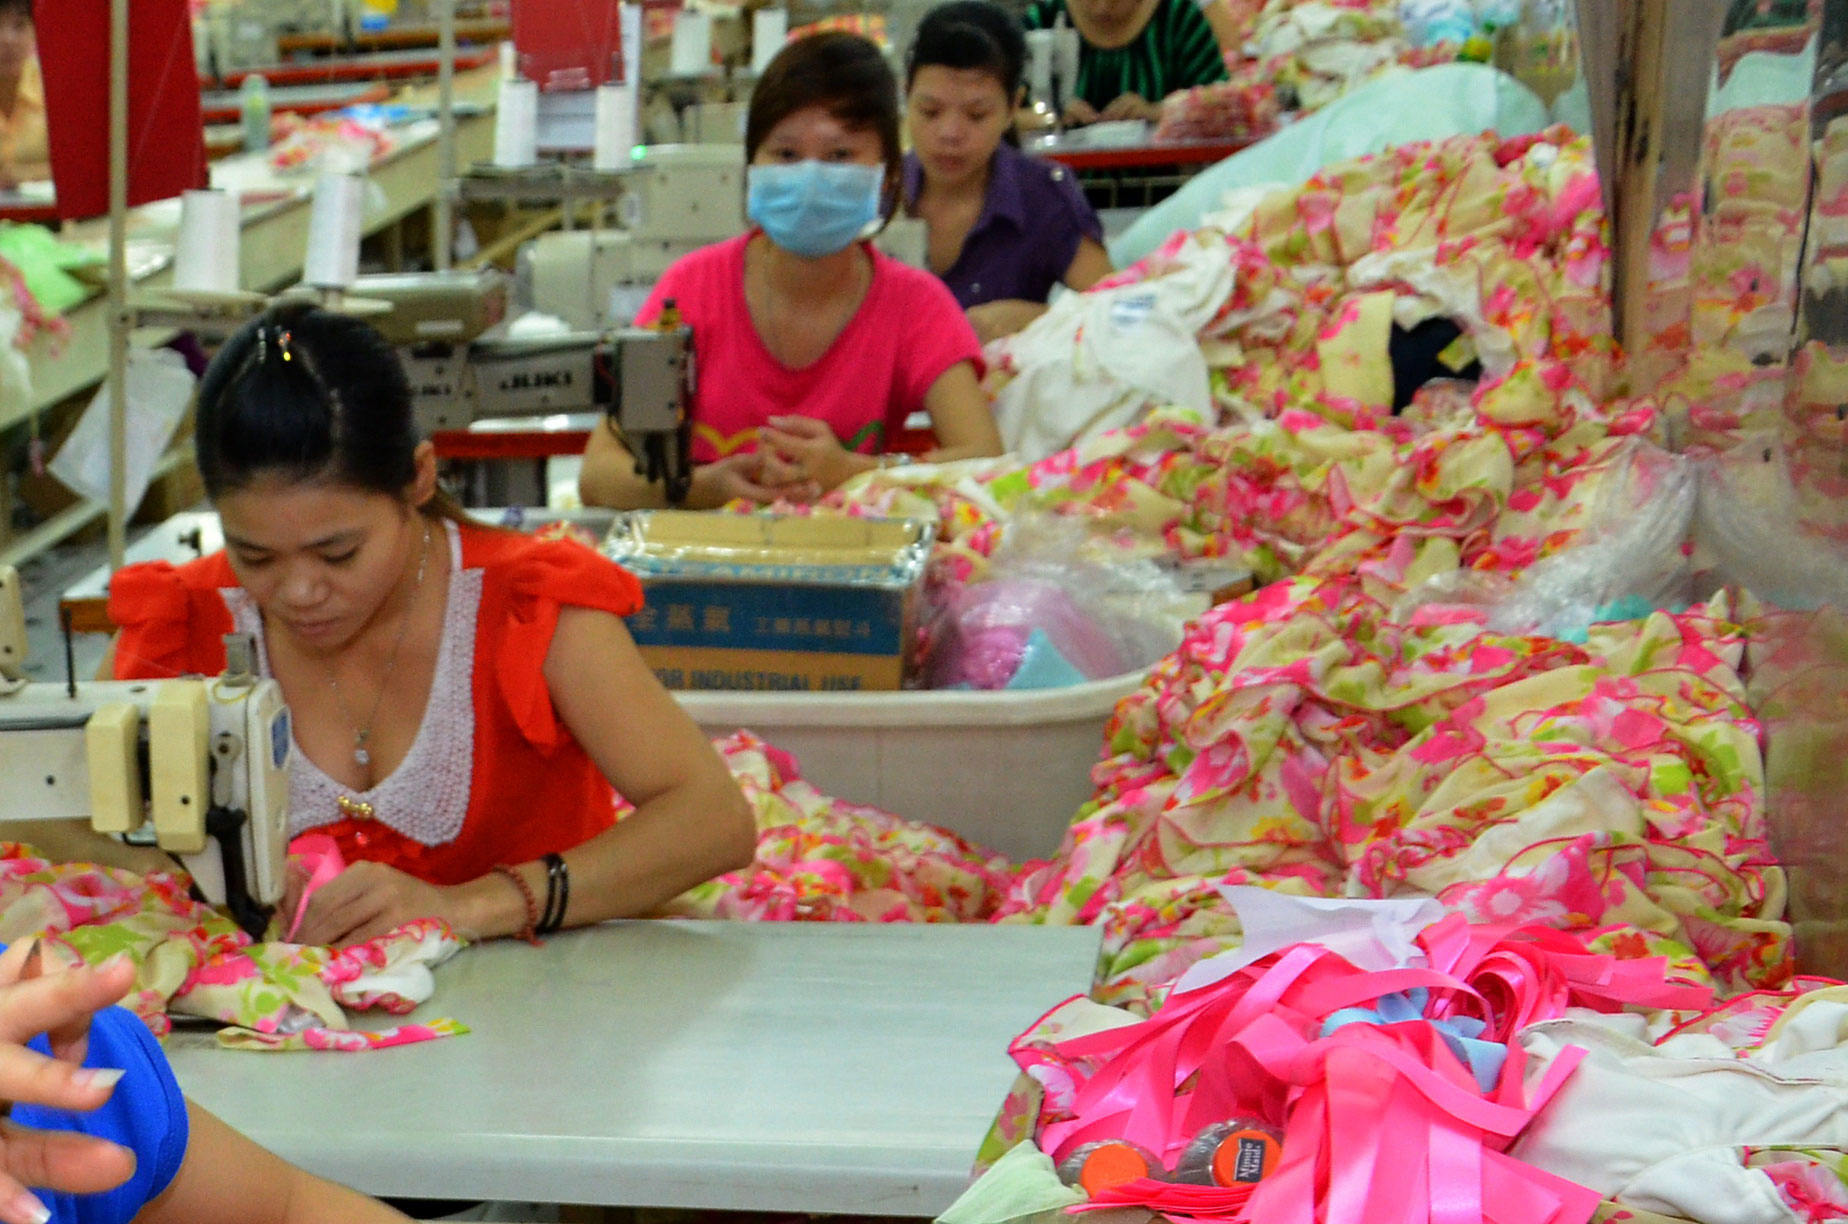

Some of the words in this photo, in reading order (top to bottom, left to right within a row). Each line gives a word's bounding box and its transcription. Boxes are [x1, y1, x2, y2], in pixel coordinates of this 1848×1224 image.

[512, 371, 573, 389] JUKI
[691, 669, 809, 690] INDUSTRIAL
[821, 674, 861, 690] USE
[1238, 1142, 1253, 1177] Minute
[1249, 1147, 1261, 1175] Maid
